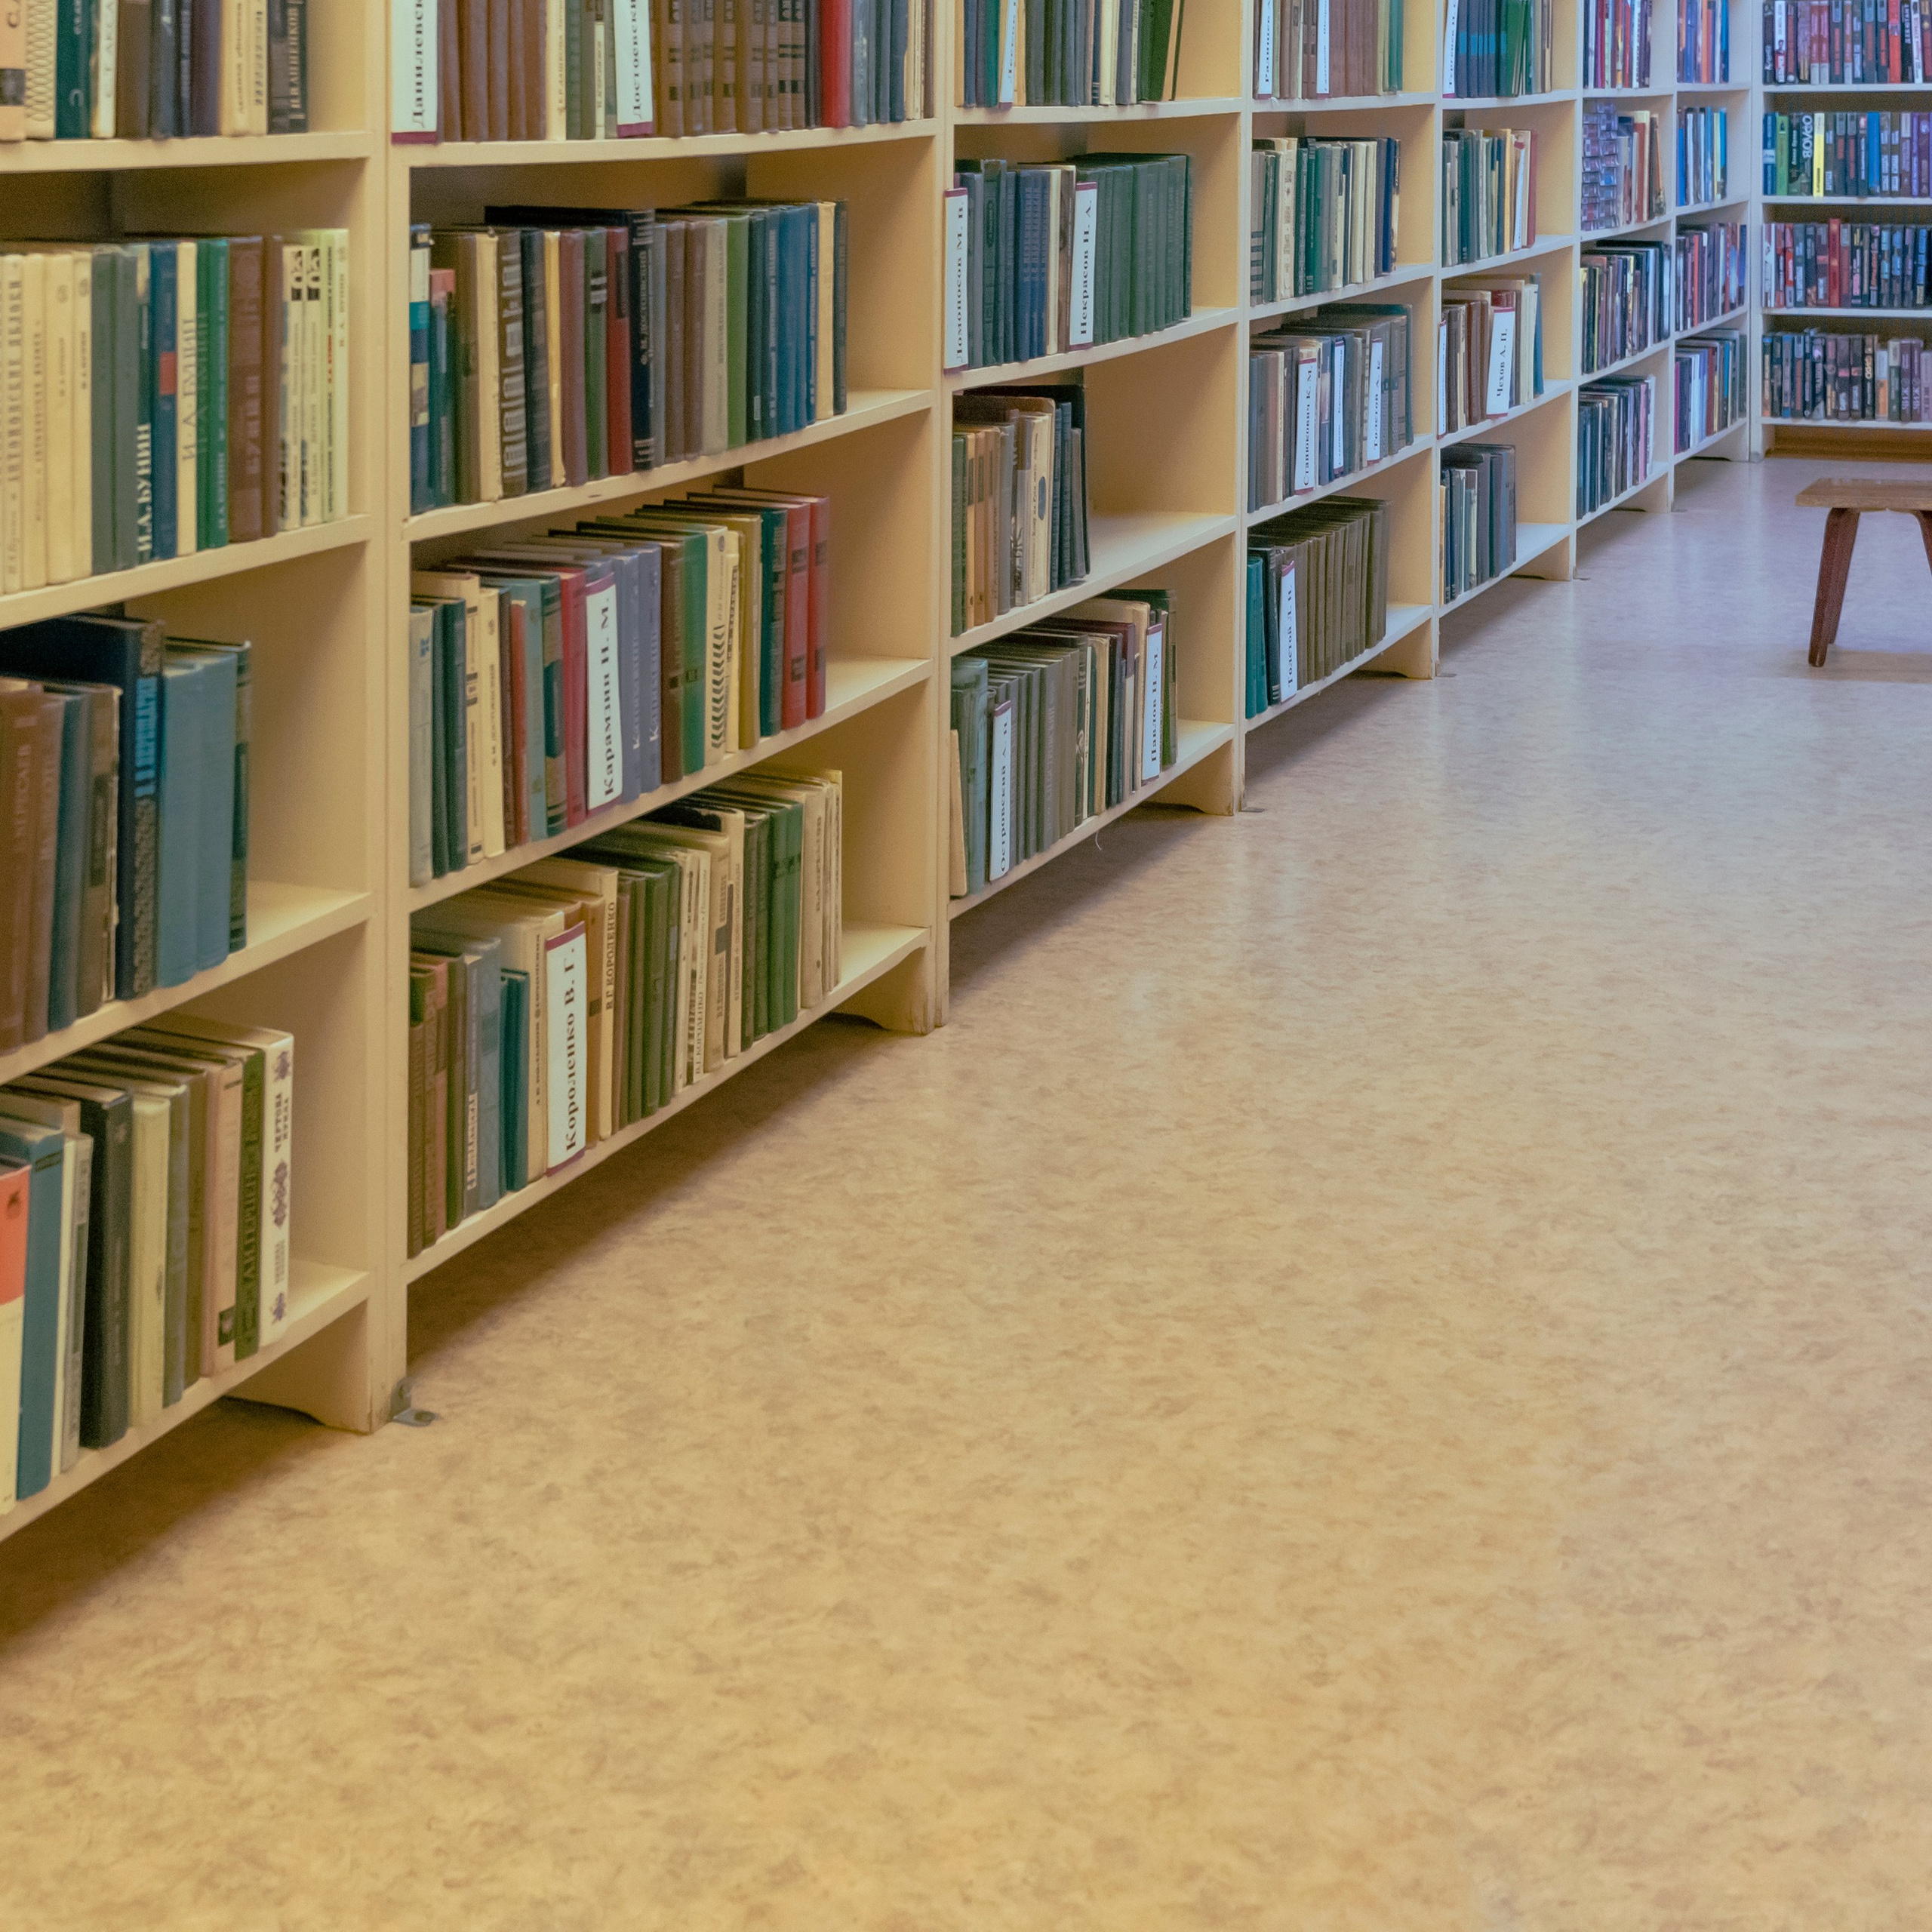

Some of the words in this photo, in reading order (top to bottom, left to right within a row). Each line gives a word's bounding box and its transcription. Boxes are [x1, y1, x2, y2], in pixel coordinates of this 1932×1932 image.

[1084, 200, 1092, 218] А.
[956, 226, 964, 250] М.
[1080, 249, 1091, 335] Некрасов
[955, 257, 964, 364] Ломоносов
[1499, 328, 1508, 342] П.
[1499, 345, 1506, 358] А.
[1306, 365, 1313, 383] М.
[1496, 361, 1506, 397] Чехов
[1305, 385, 1312, 399] К.
[1303, 403, 1312, 486] Станюкович
[600, 597, 609, 631] М.
[1286, 605, 1293, 621] Л.
[601, 637, 609, 666] Н.
[1152, 647, 1159, 670] М.
[602, 672, 615, 797] Карамзин
[1001, 740, 1008, 758] А.
[1000, 764, 1008, 872] Островский
[606, 901, 616, 986] КОРОЛЕНКО
[563, 946, 574, 973] Г.
[562, 979, 574, 1007] В.
[562, 1012, 580, 1152] Короленко
